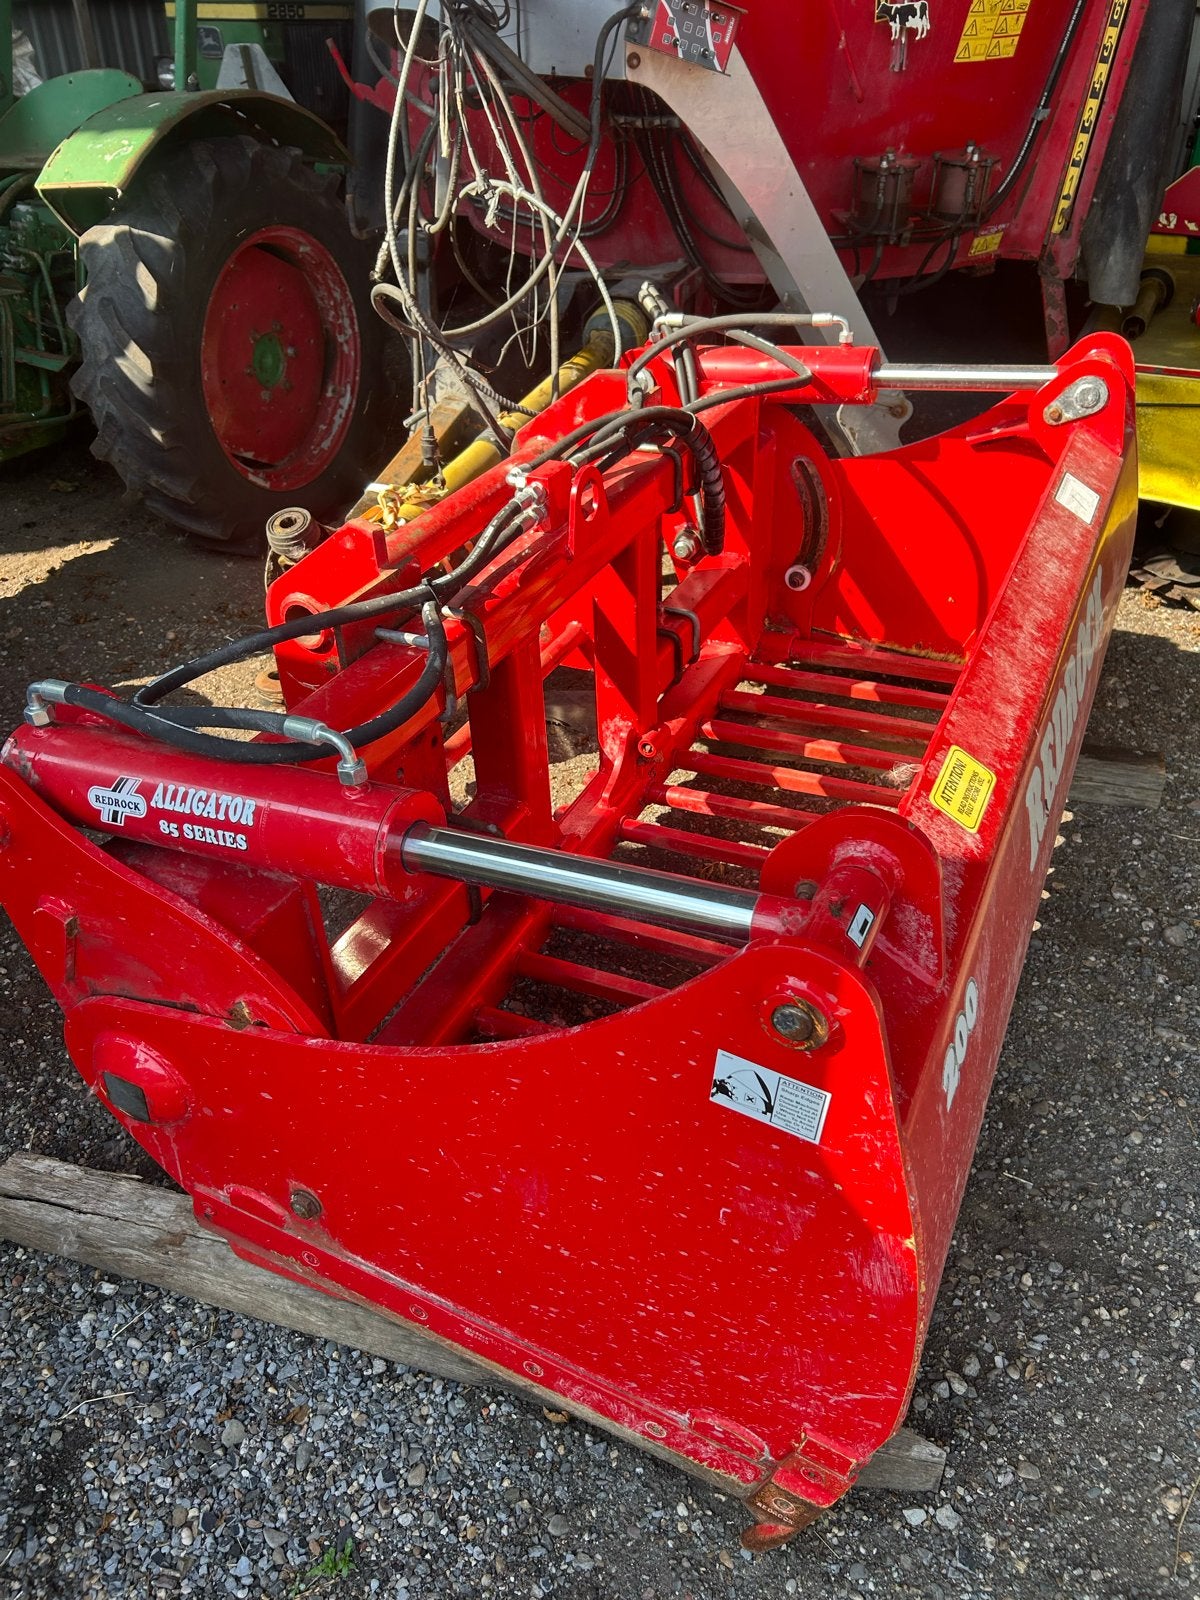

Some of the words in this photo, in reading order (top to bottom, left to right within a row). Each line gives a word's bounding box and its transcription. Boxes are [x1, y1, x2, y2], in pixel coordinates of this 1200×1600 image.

[267, 4, 305, 18] 2850
[1103, 36, 1114, 57] 5
[1094, 71, 1103, 94] 4
[1083, 106, 1093, 127] 3
[1074, 141, 1084, 162] 2
[941, 757, 966, 805] ATTENTION!
[94, 793, 141, 812] REDROCK
[150, 782, 256, 826] ALLIGATOR
[159, 819, 180, 838] 85
[183, 823, 248, 850] SERIES
[942, 977, 979, 1113] 200
[782, 1080, 823, 1099] ATTENTION
[756, 1501, 795, 1525] REDROCK
